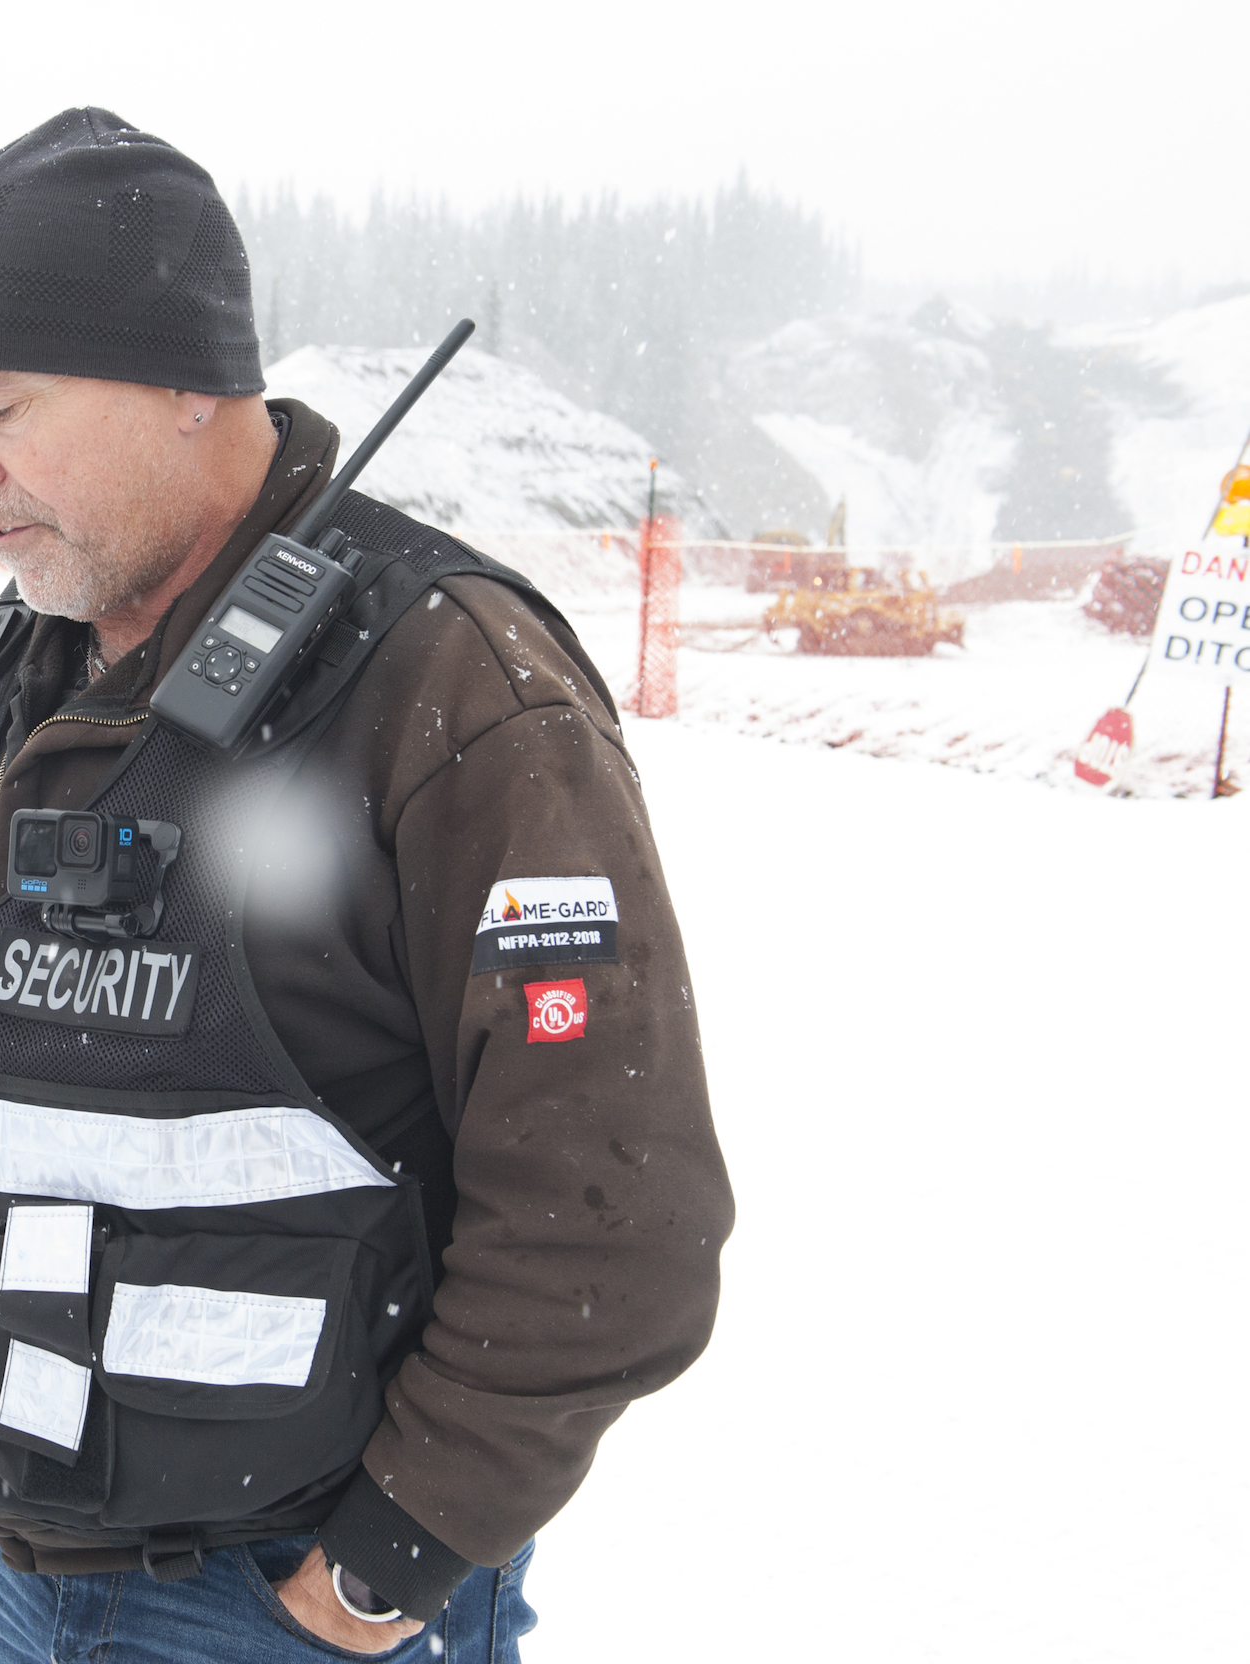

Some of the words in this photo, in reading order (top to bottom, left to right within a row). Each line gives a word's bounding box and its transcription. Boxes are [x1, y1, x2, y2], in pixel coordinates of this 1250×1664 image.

[276, 550, 317, 575] KENWOOD
[1181, 551, 1249, 582] DAN
[119, 828, 132, 841] 10
[21, 878, 48, 887] GoPro
[497, 931, 601, 950] NFPA-2112-2018
[535, 990, 577, 1009] CLASSIFIED
[533, 1016, 540, 1028] C
[573, 1011, 585, 1024] US
